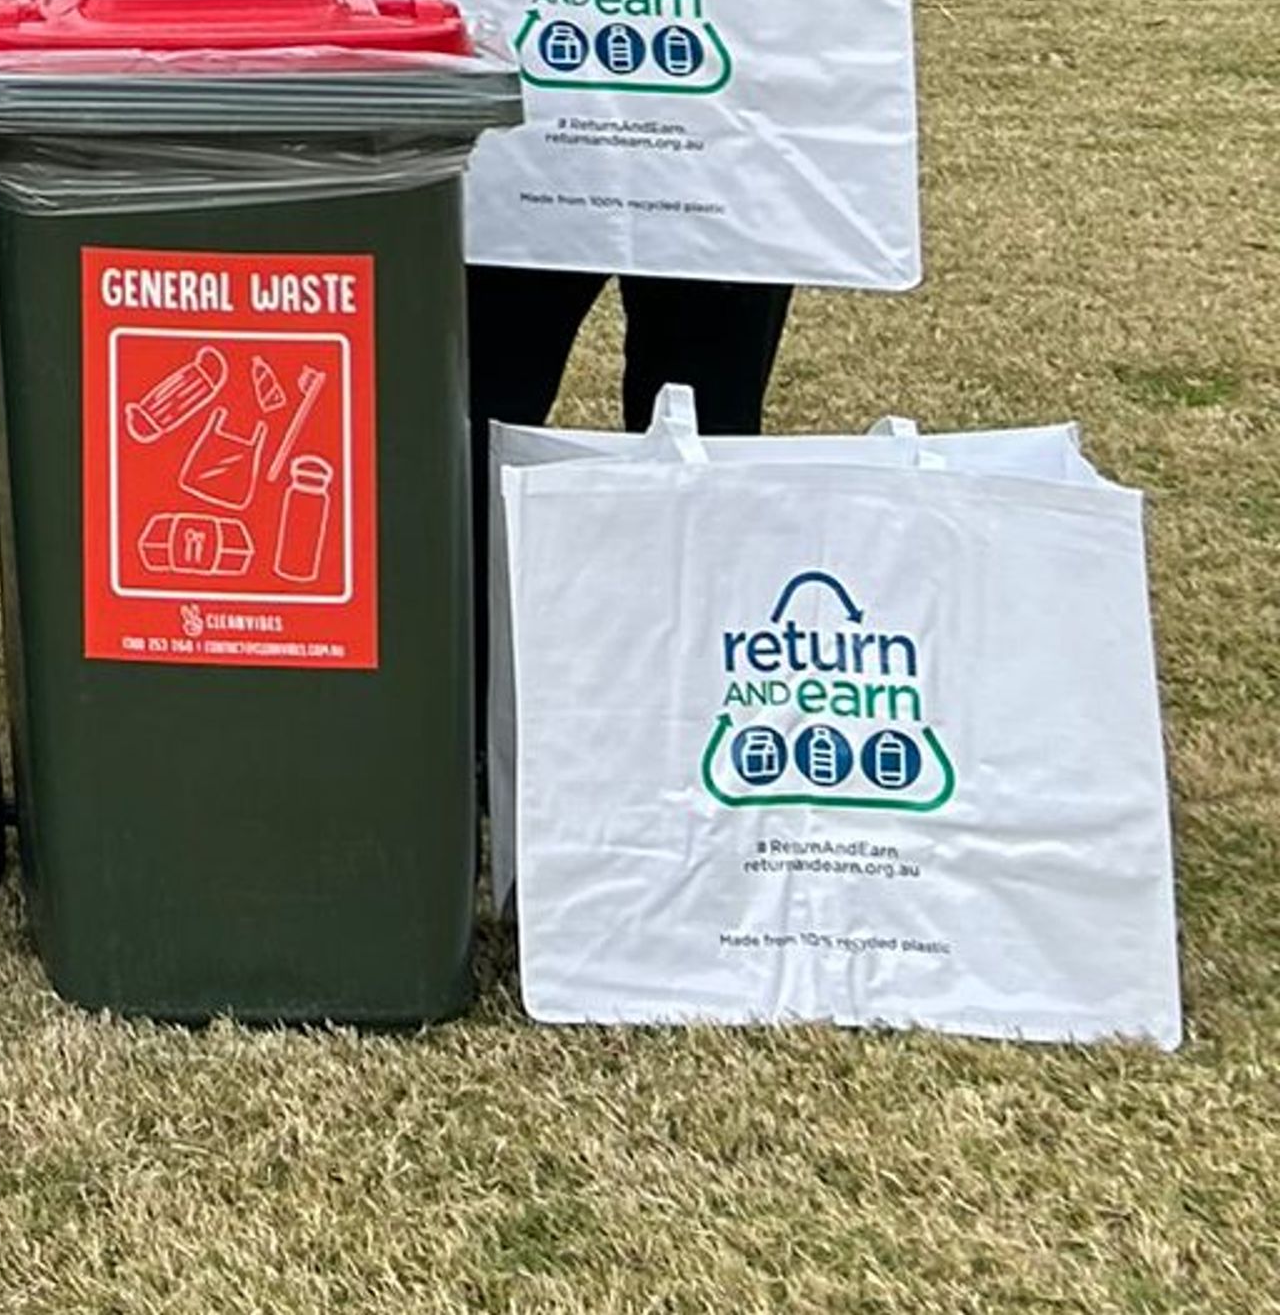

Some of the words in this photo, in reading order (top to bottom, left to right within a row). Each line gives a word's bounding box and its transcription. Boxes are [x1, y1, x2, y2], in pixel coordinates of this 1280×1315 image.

[520, 193, 554, 204] Made
[557, 194, 586, 205] from
[590, 195, 623, 208] 100%
[627, 199, 681, 213] recycled
[684, 202, 726, 214] plastic
[101, 268, 233, 312] GENERAL
[250, 273, 356, 314] WASTE
[723, 621, 917, 676] return
[723, 681, 791, 706] AND
[797, 678, 921, 721] earn
[720, 934, 759, 947] Made
[764, 934, 797, 947] from
[836, 938, 898, 953] recycled
[902, 939, 951, 954] plastic
